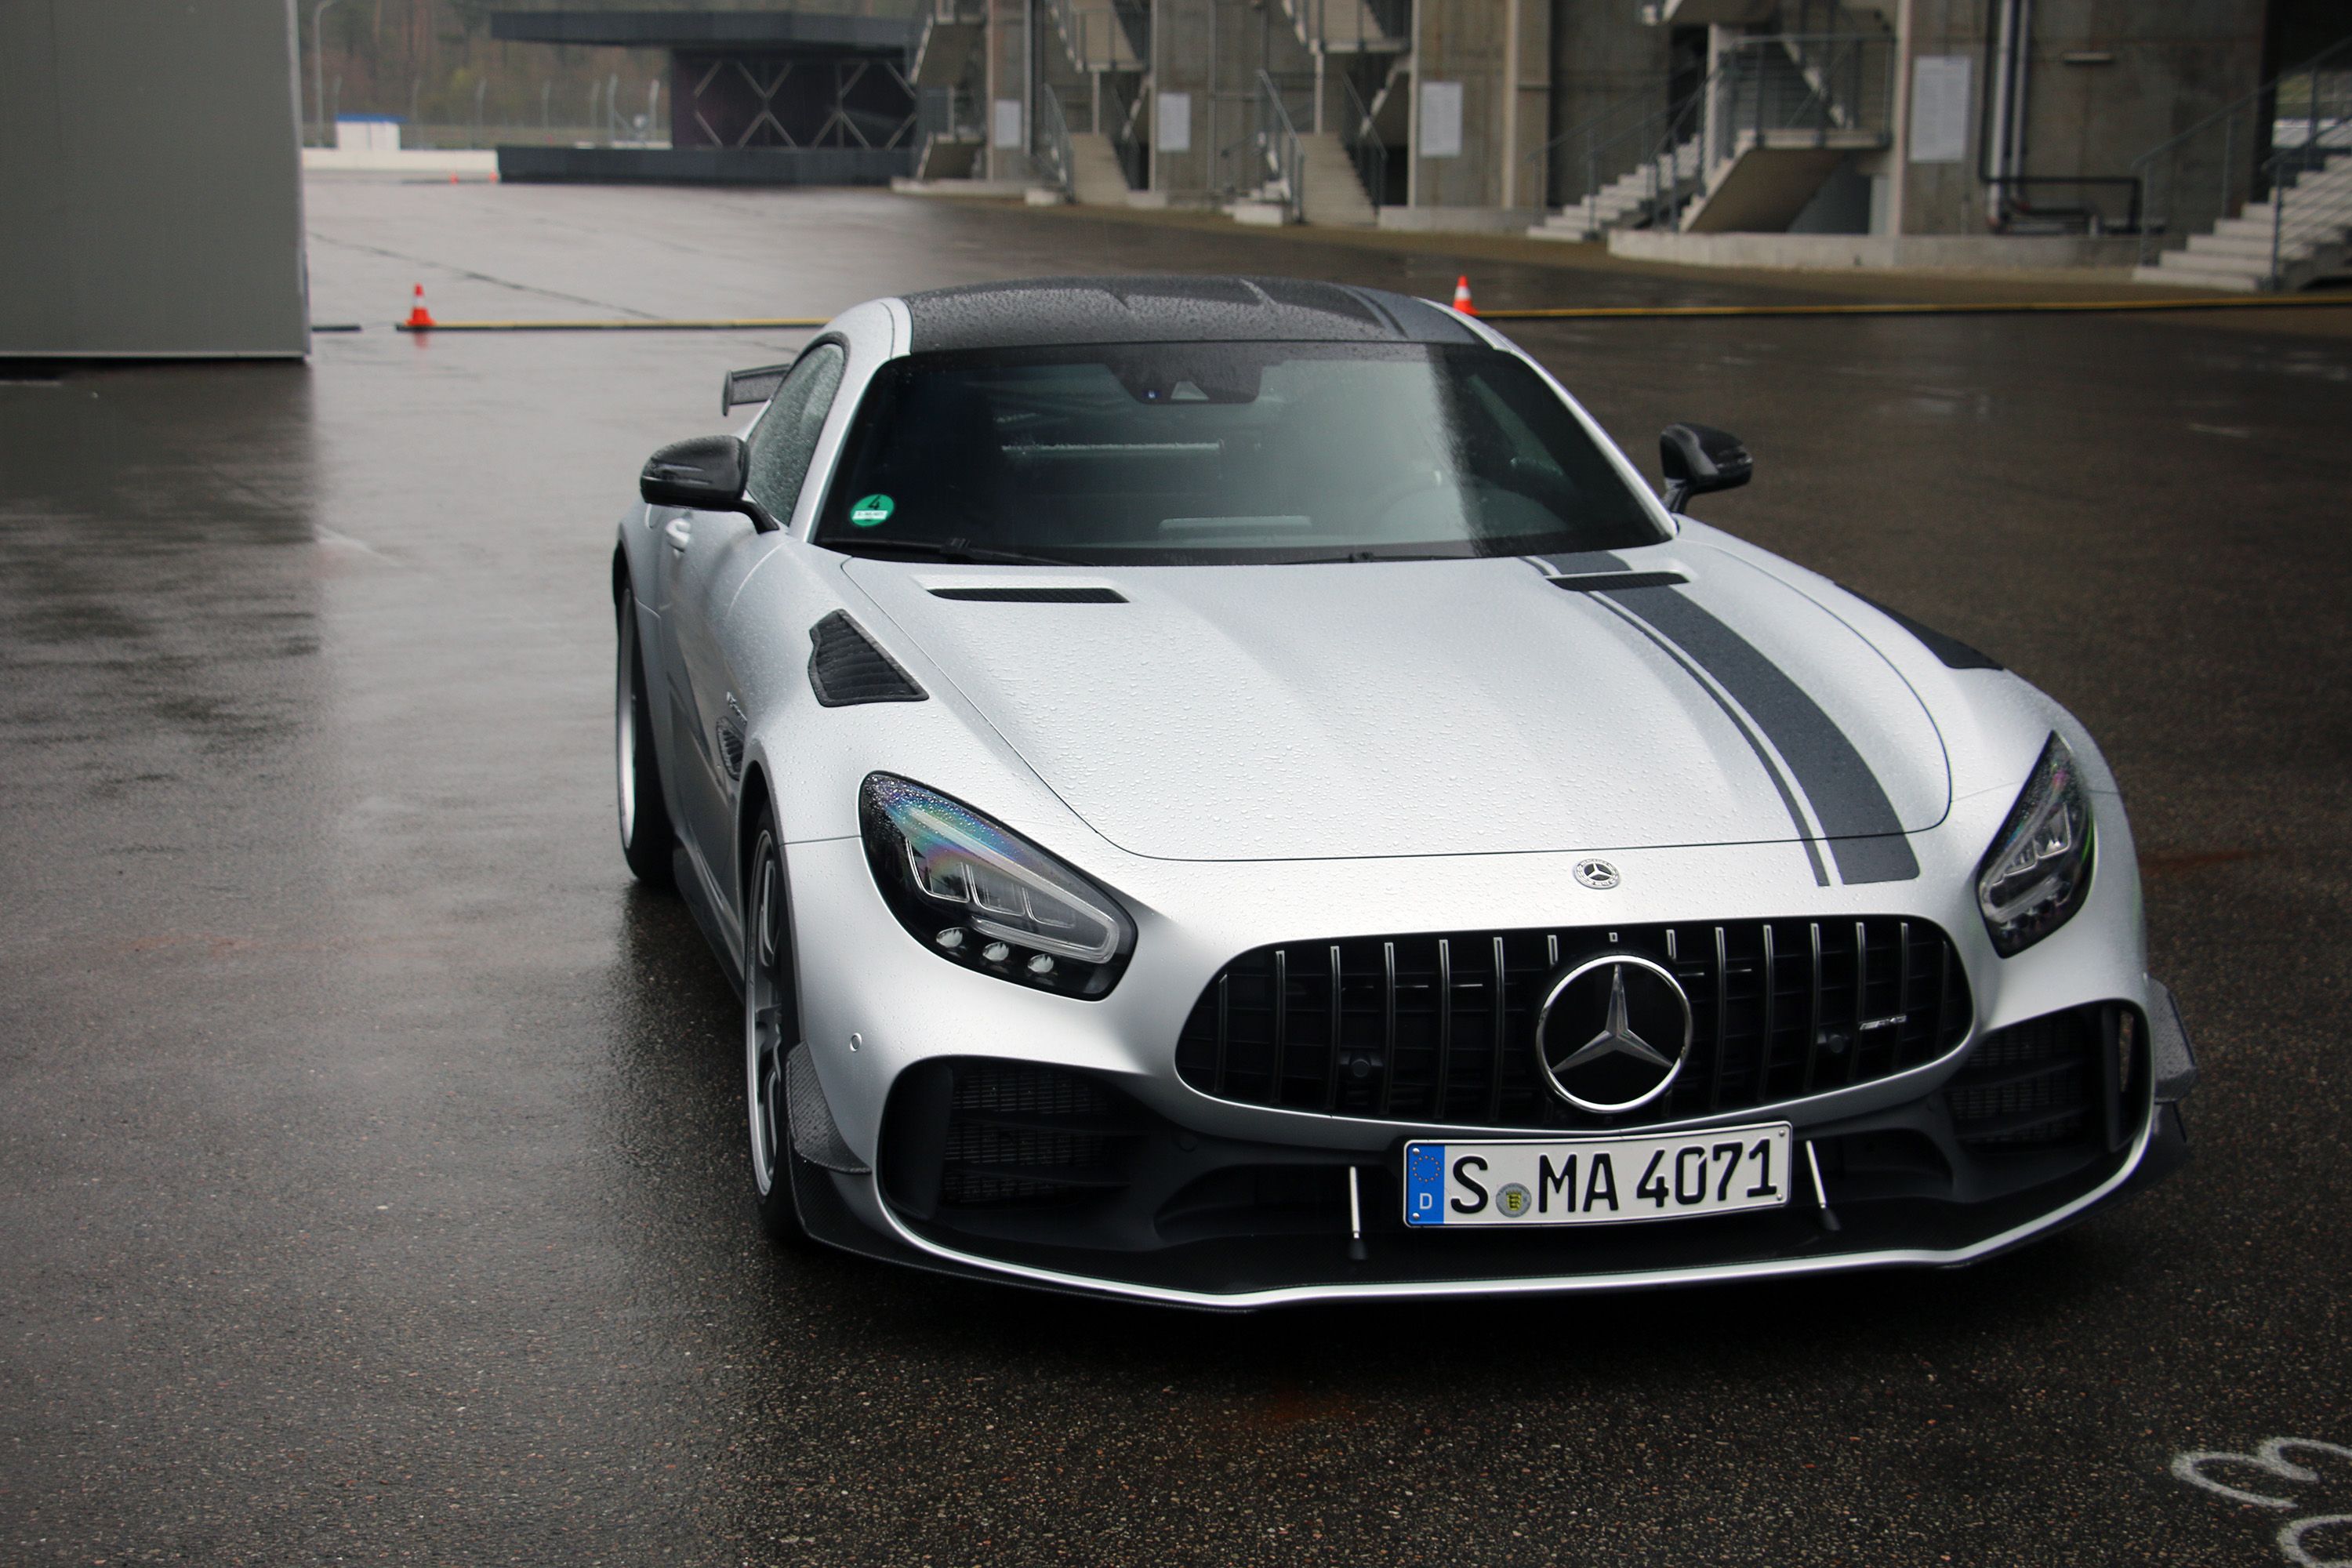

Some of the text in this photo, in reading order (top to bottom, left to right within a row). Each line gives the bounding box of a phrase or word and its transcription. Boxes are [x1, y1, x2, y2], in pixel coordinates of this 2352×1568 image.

[868, 495, 880, 510] 4
[1450, 1155, 1489, 1214] S
[1538, 1152, 1619, 1213] MA
[1636, 1138, 1778, 1208] 4071
[1420, 1192, 1433, 1210] D
